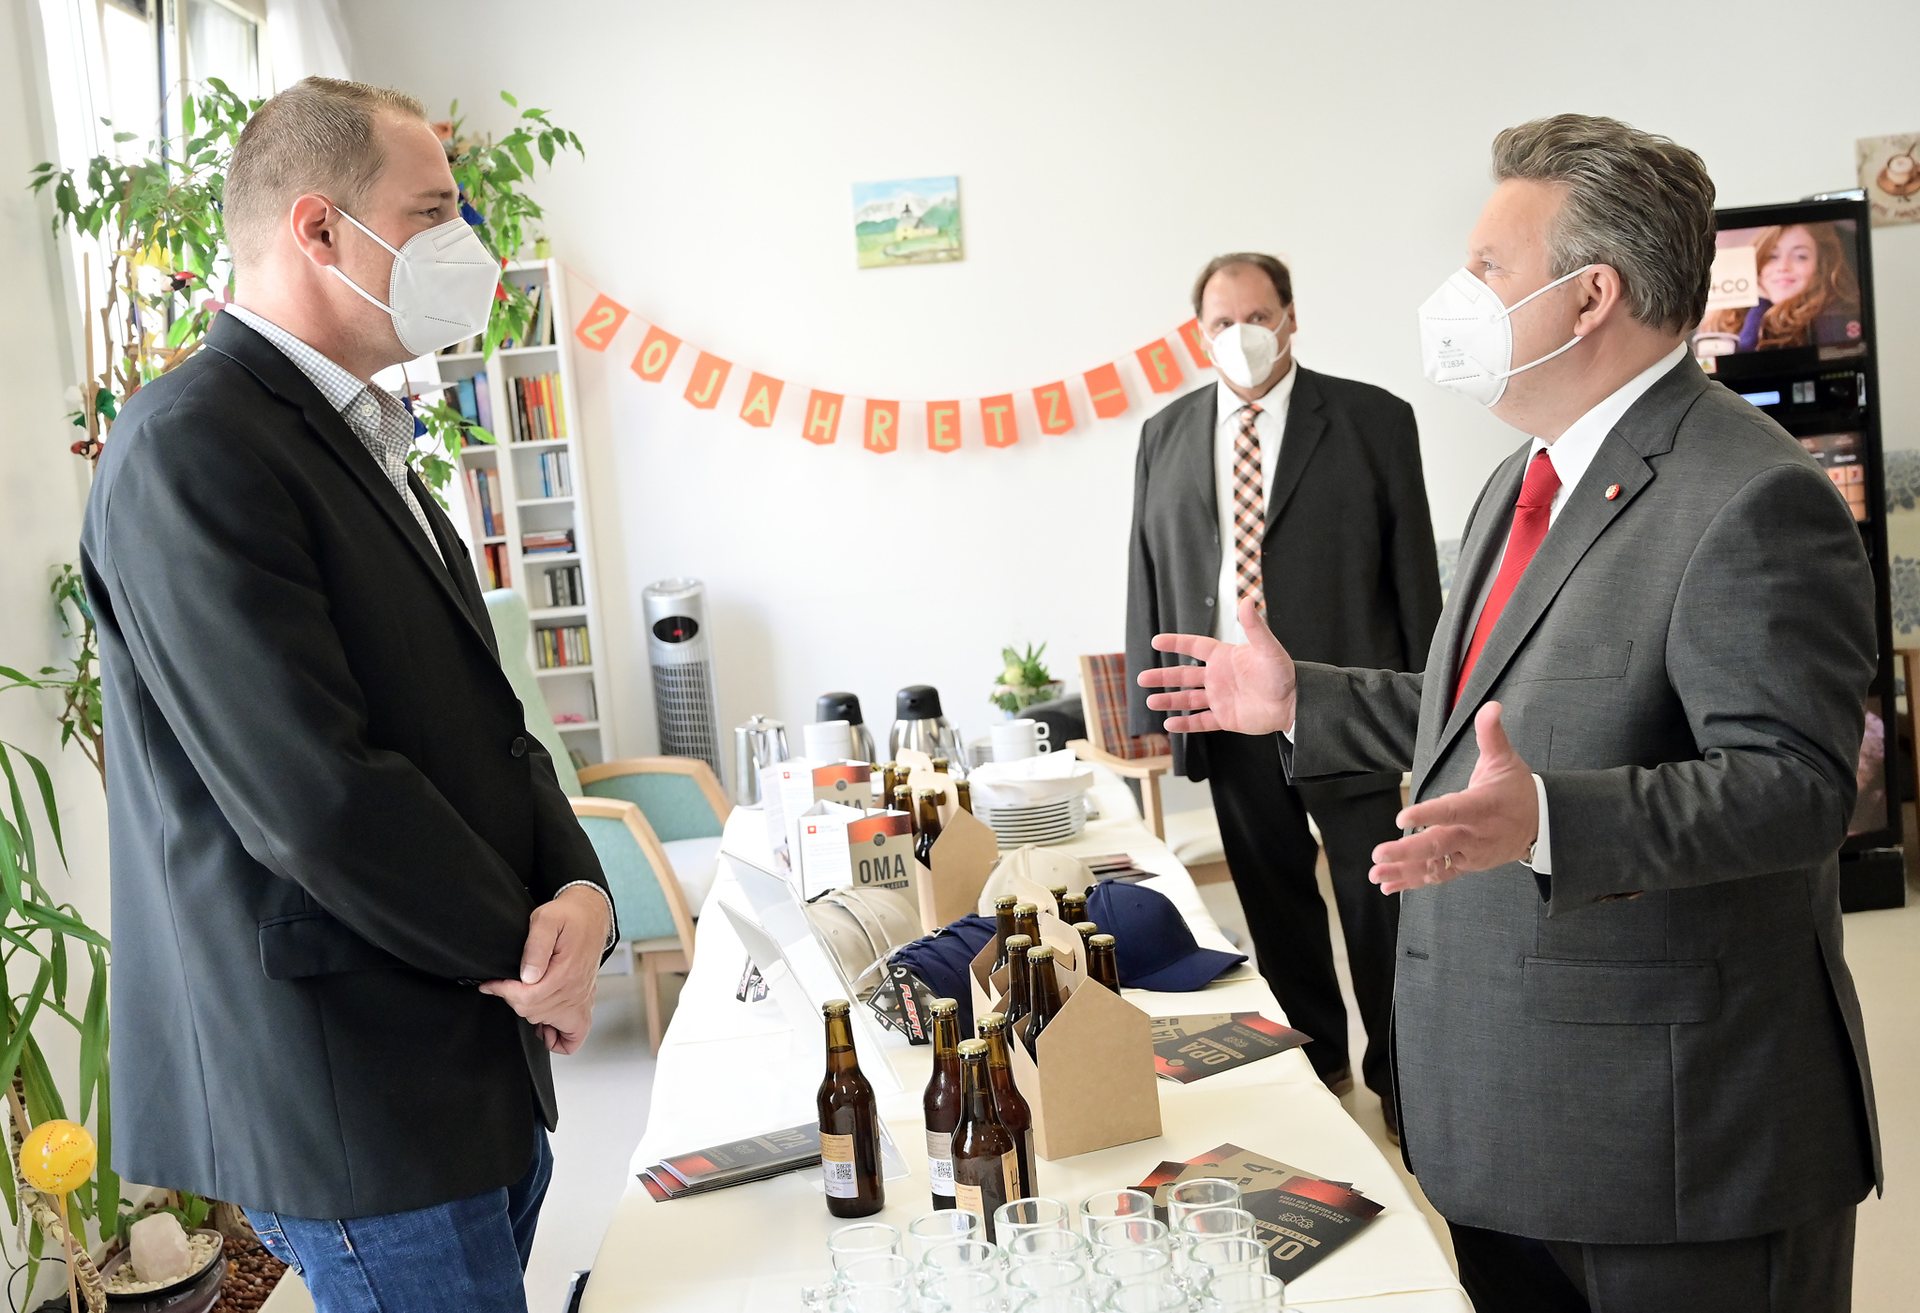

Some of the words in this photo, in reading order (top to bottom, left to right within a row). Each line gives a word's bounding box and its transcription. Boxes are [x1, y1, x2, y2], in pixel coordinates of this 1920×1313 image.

[859, 854, 906, 884] OMA
[900, 983, 924, 1040] FLEXFIT
[1177, 1041, 1231, 1065] OPA
[766, 1130, 814, 1150] OPA
[1259, 1220, 1279, 1231] LAGE
[1256, 1229, 1304, 1261] OP
